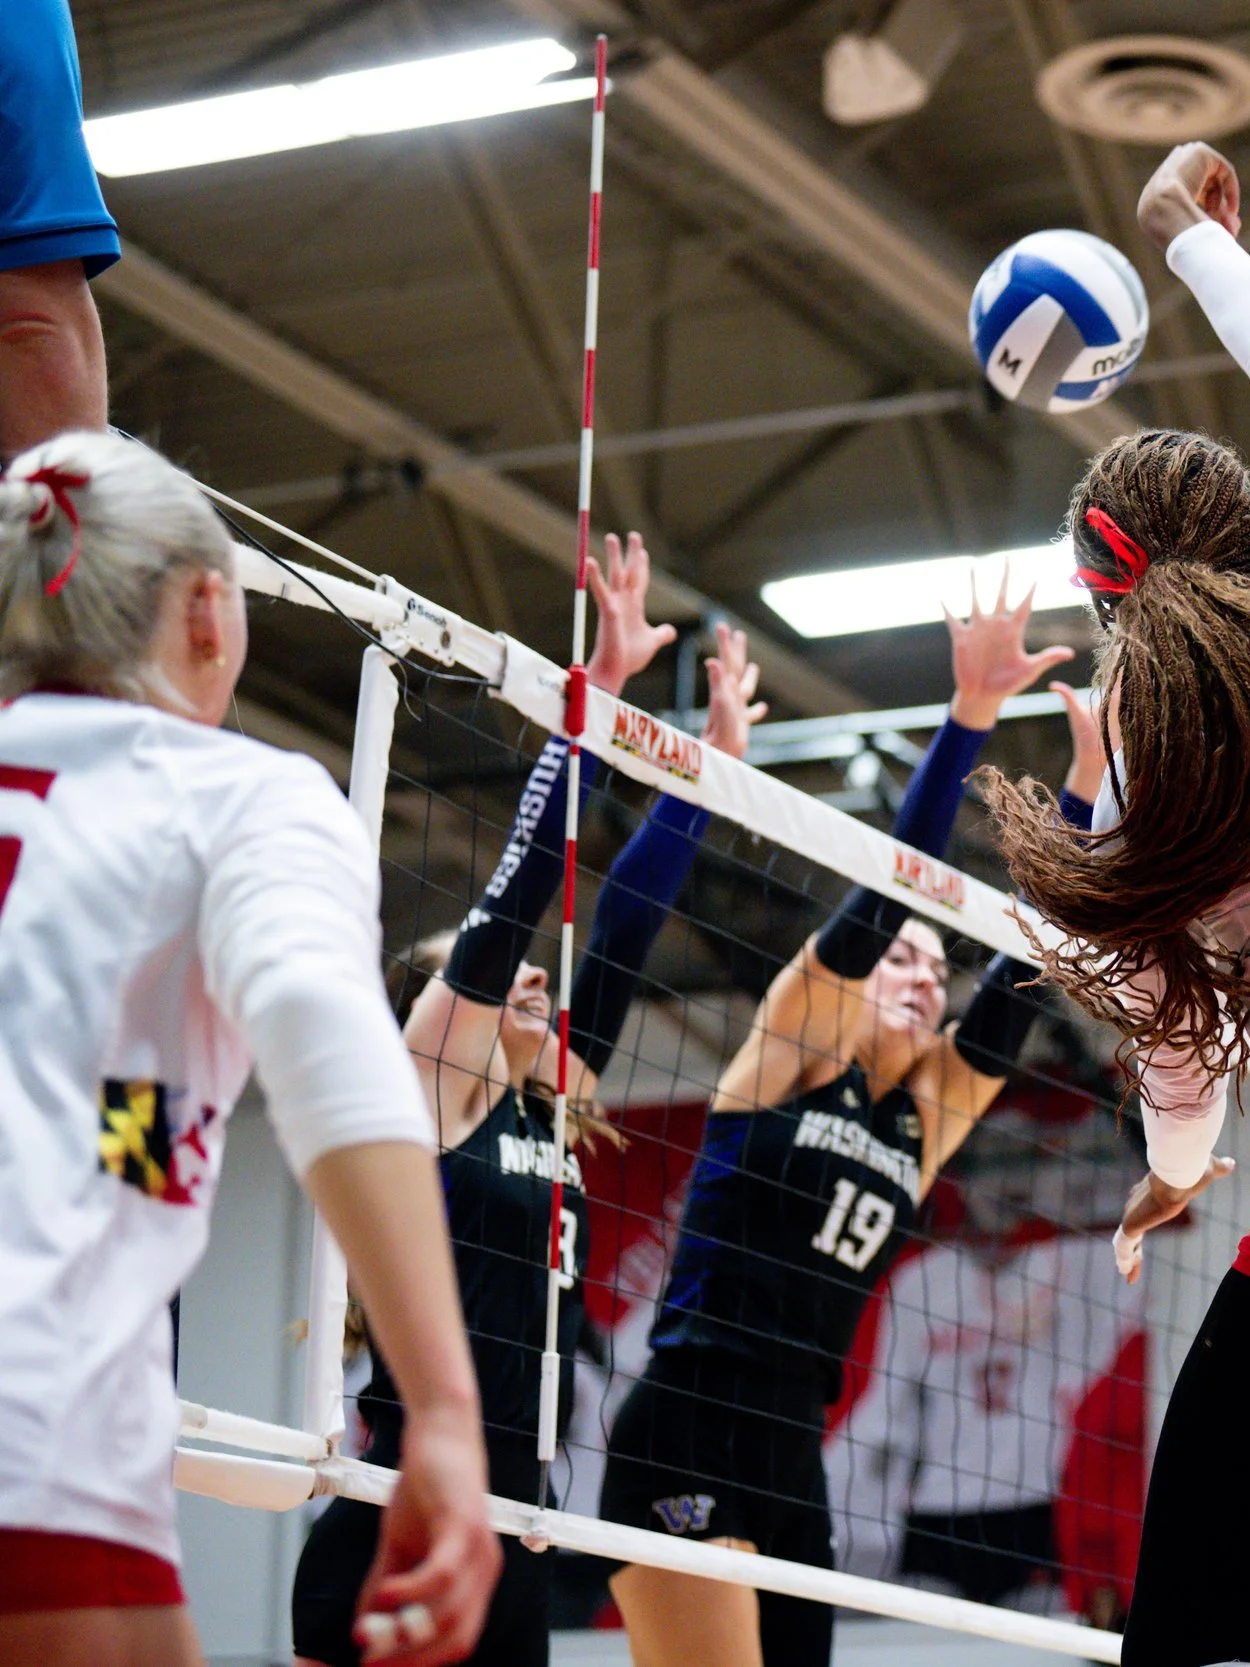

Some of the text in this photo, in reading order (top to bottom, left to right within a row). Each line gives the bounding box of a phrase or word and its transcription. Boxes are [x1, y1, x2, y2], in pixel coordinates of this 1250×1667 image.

[613, 703, 702, 776] MARYLAND
[811, 1177, 896, 1273] 19
[652, 1494, 716, 1534] W
